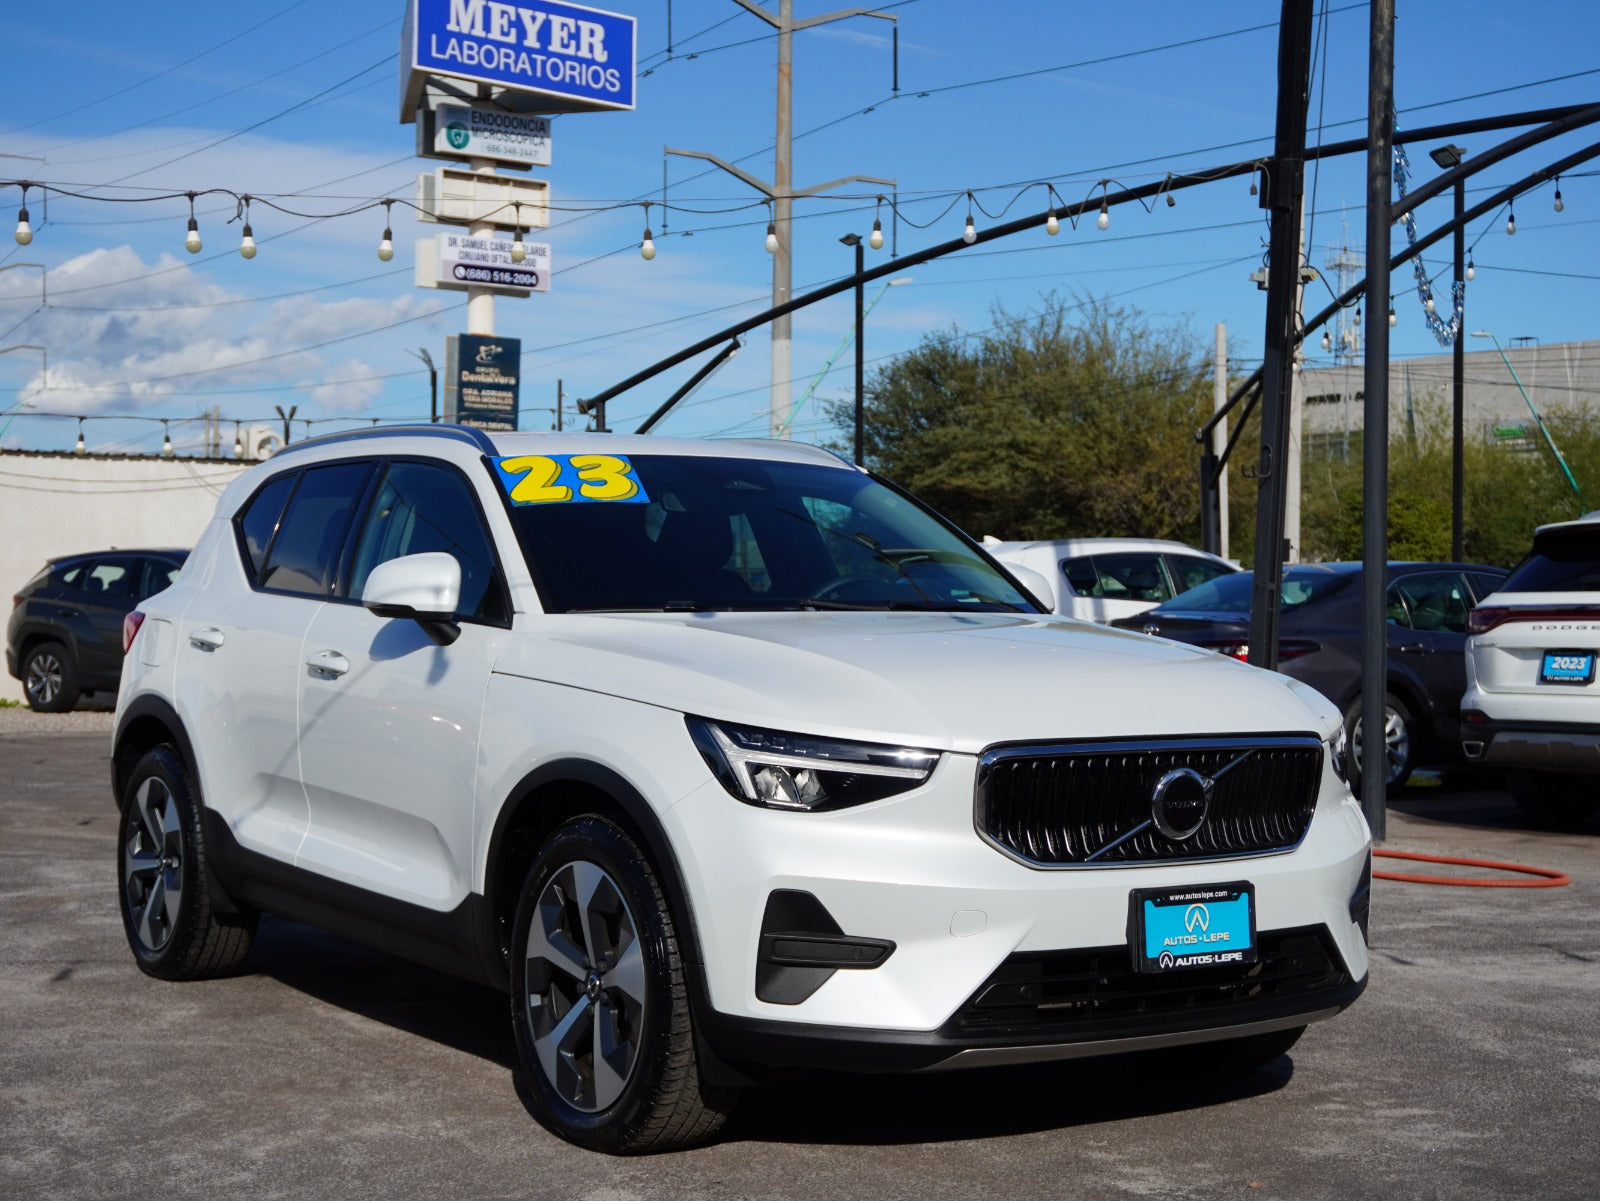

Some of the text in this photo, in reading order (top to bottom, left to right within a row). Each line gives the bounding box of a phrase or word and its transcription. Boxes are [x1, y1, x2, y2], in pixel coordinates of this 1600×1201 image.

[446, 0, 608, 62] MEYER
[431, 34, 621, 92] LABORATORIOS
[471, 110, 546, 133] ENDODONCIA
[448, 237, 459, 247] DR.
[461, 239, 488, 251] SAMUEL
[458, 251, 489, 263] CIRUJANO
[466, 268, 537, 285] (686) 516-2004
[499, 454, 640, 502] 23
[1551, 656, 1587, 670] 2023
[1169, 890, 1228, 901] www.autoslepe.com
